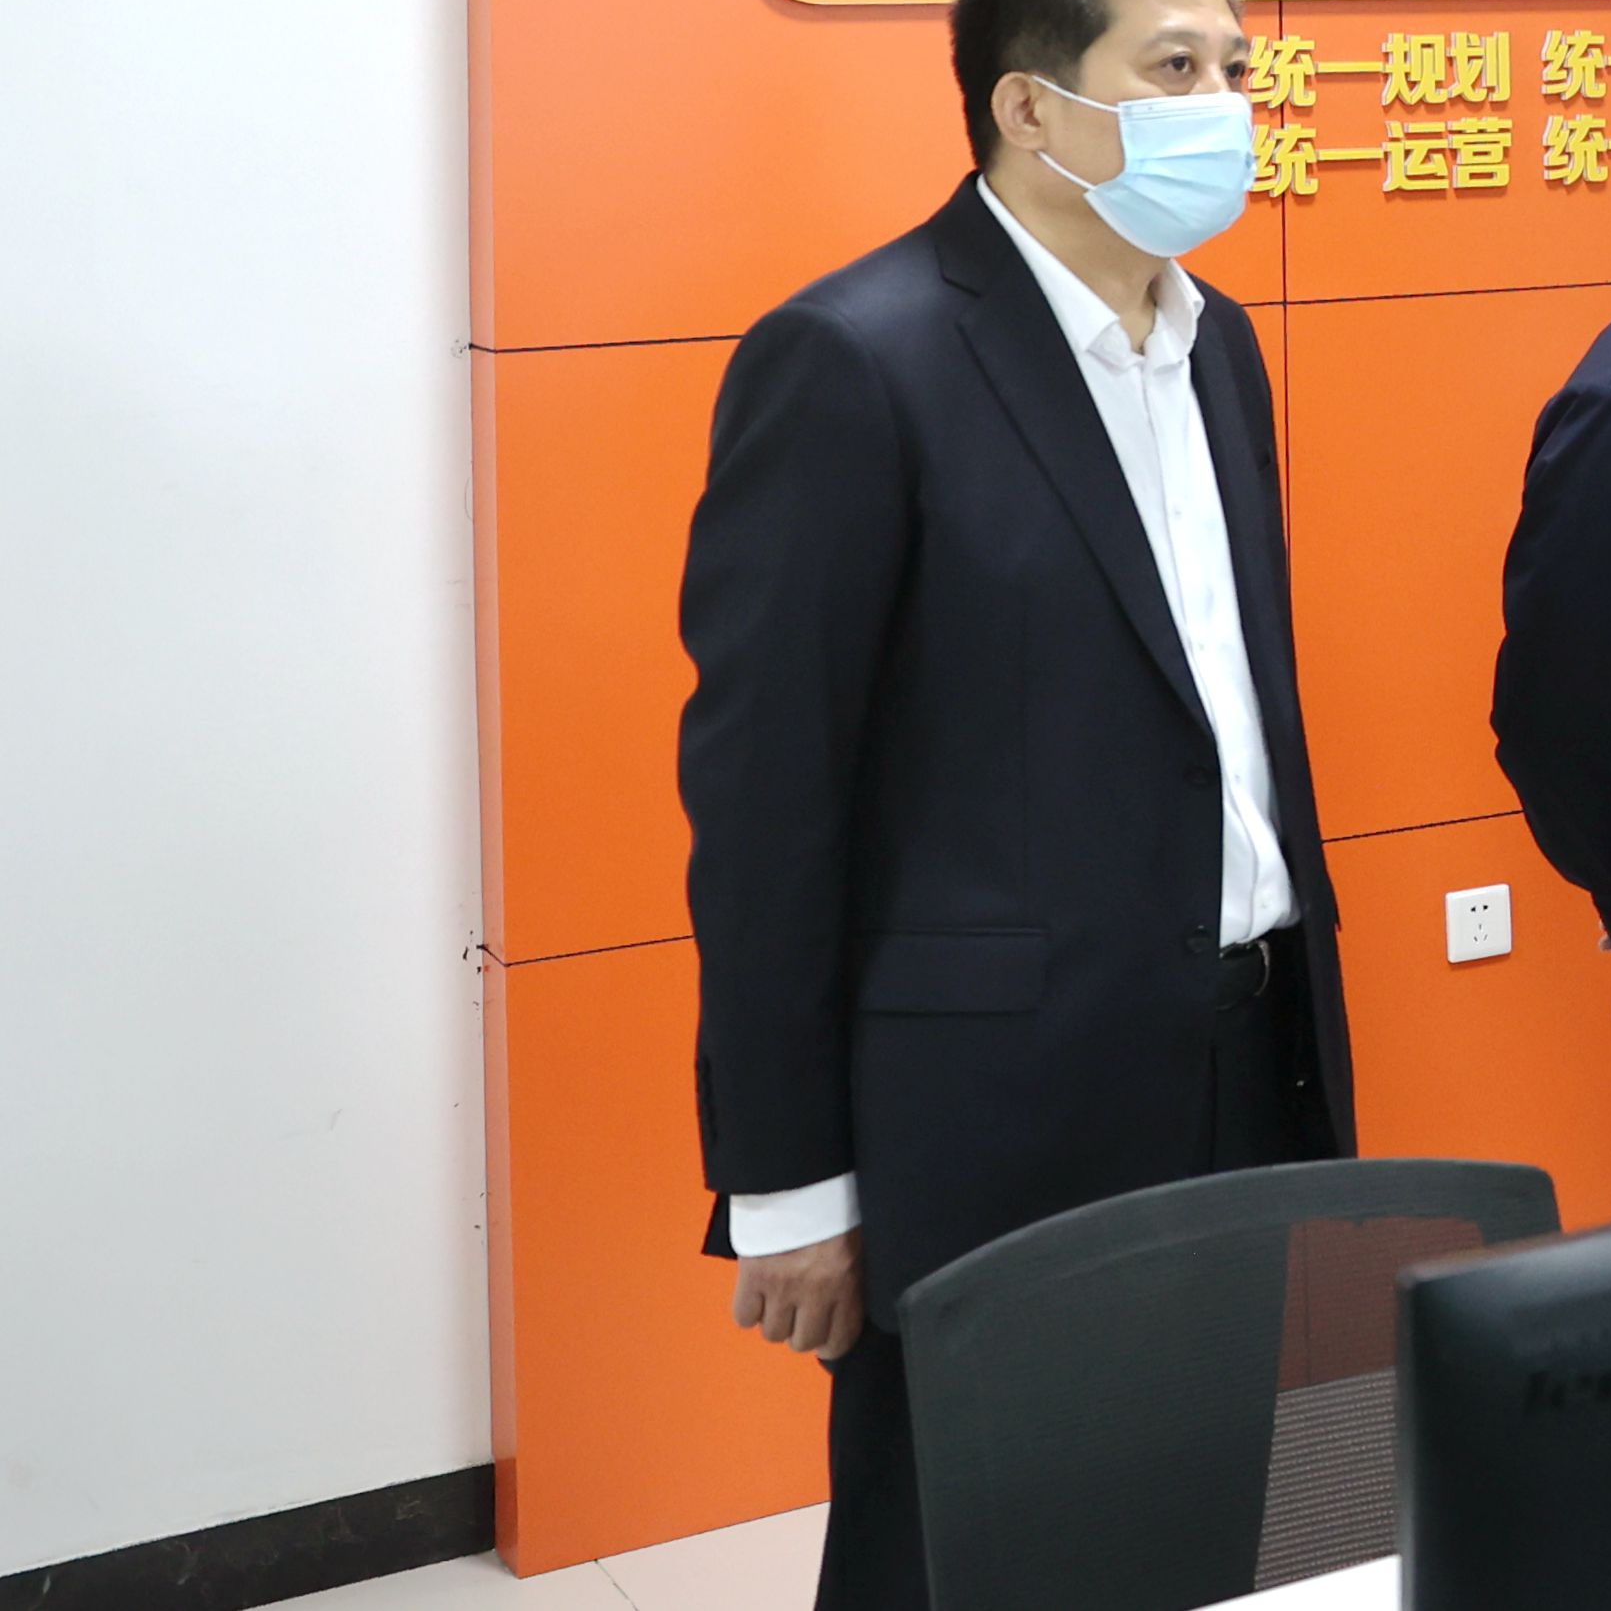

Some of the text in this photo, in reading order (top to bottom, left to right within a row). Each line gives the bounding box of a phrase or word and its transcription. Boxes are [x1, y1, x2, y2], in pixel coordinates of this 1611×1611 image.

[1247, 31, 1512, 109] 统一规划
[1249, 117, 1513, 198] 统一运营
